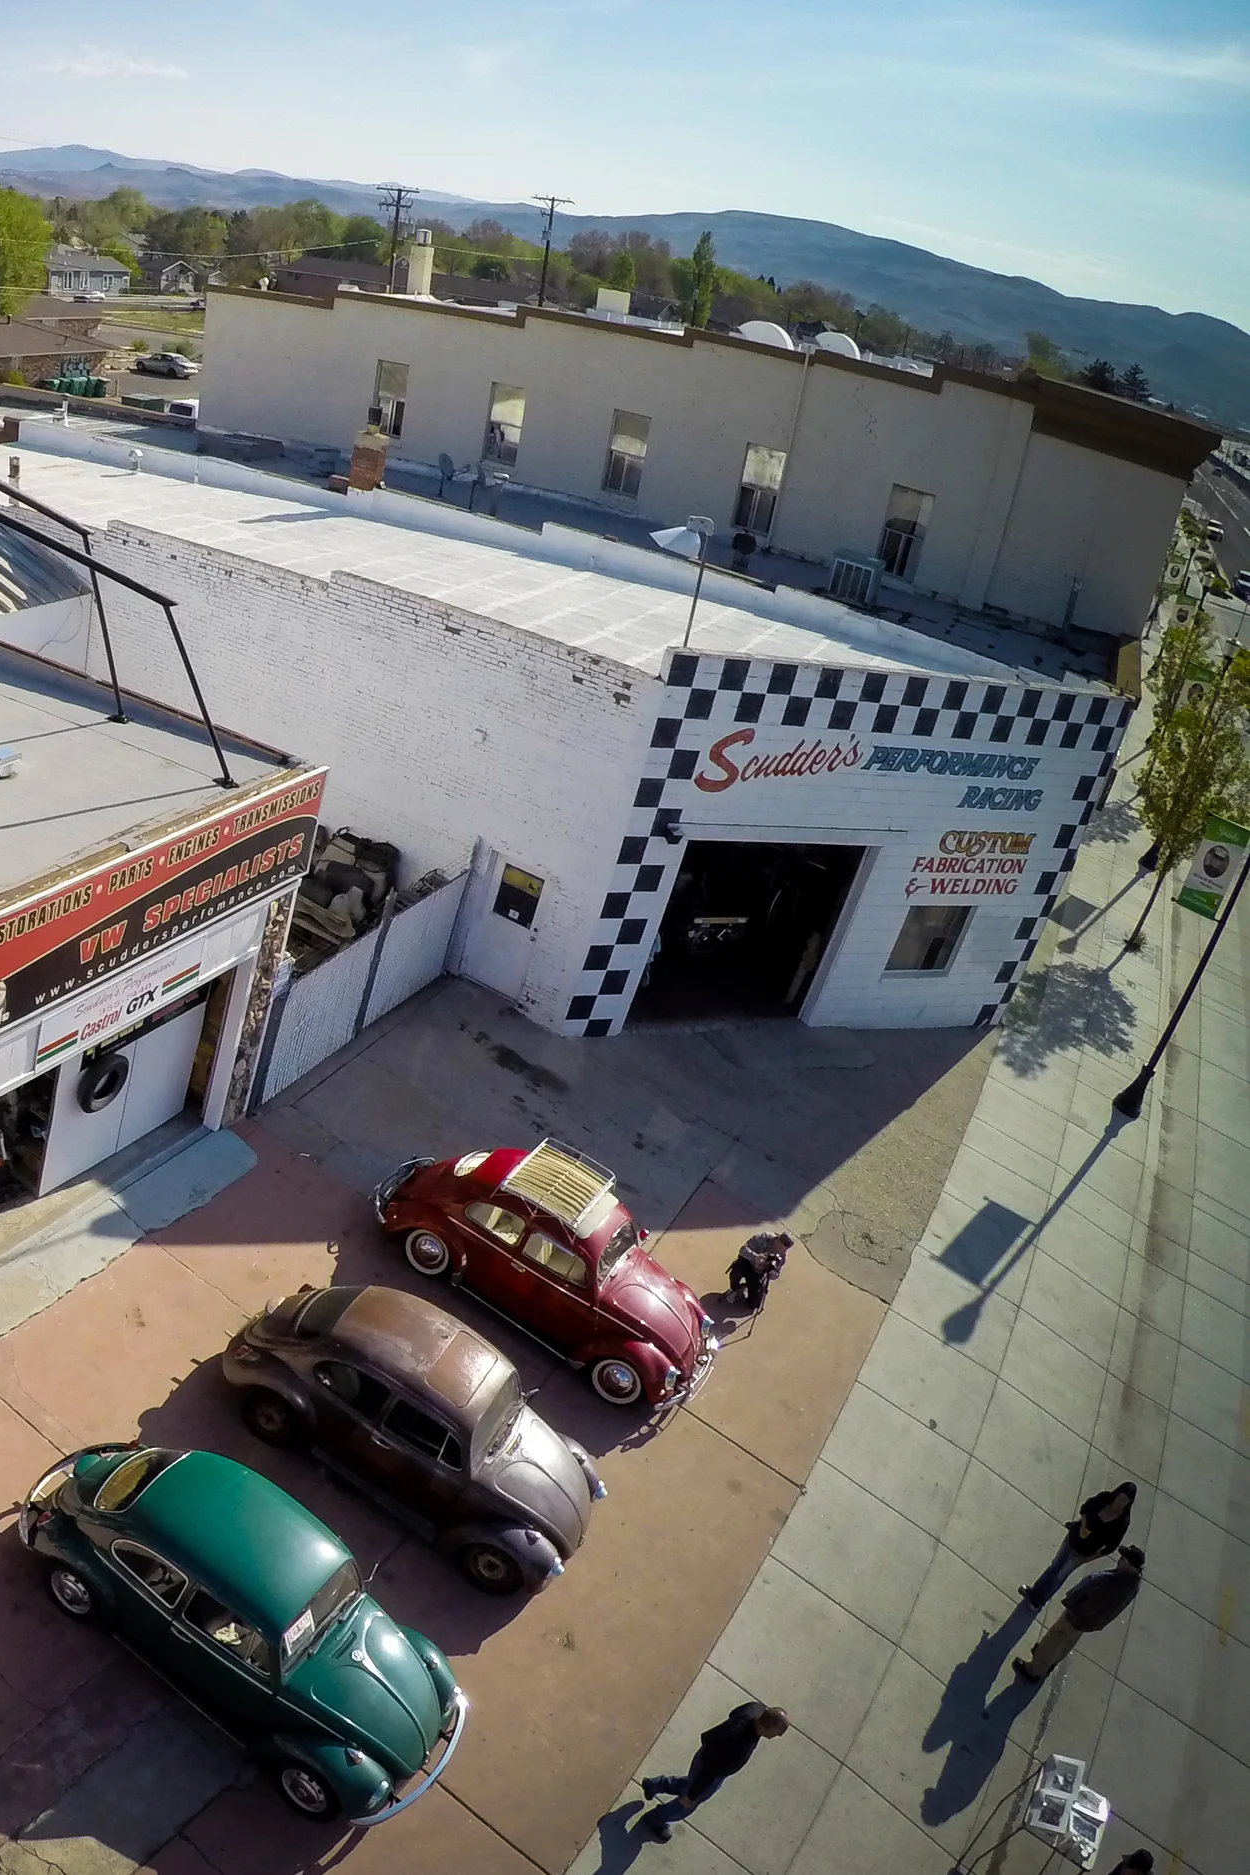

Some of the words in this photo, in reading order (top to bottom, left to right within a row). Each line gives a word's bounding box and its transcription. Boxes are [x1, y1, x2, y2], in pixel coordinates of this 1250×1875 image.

[693, 727, 864, 793] Scudder's
[860, 745, 1042, 781] PERFORMANCE
[956, 785, 1044, 812] RACING
[107, 857, 154, 895] PARTS
[166, 825, 221, 867] ENGINES
[231, 780, 320, 835] TRANSMISSIONS
[938, 829, 1037, 856] CUSTOM
[910, 855, 1028, 876] FABRICATION
[928, 877, 1020, 896] WELDING
[79, 919, 128, 965] VW
[142, 832, 305, 932] SPECIALISTS
[80, 1005, 123, 1041] Castrol
[125, 984, 160, 1015] GTX
